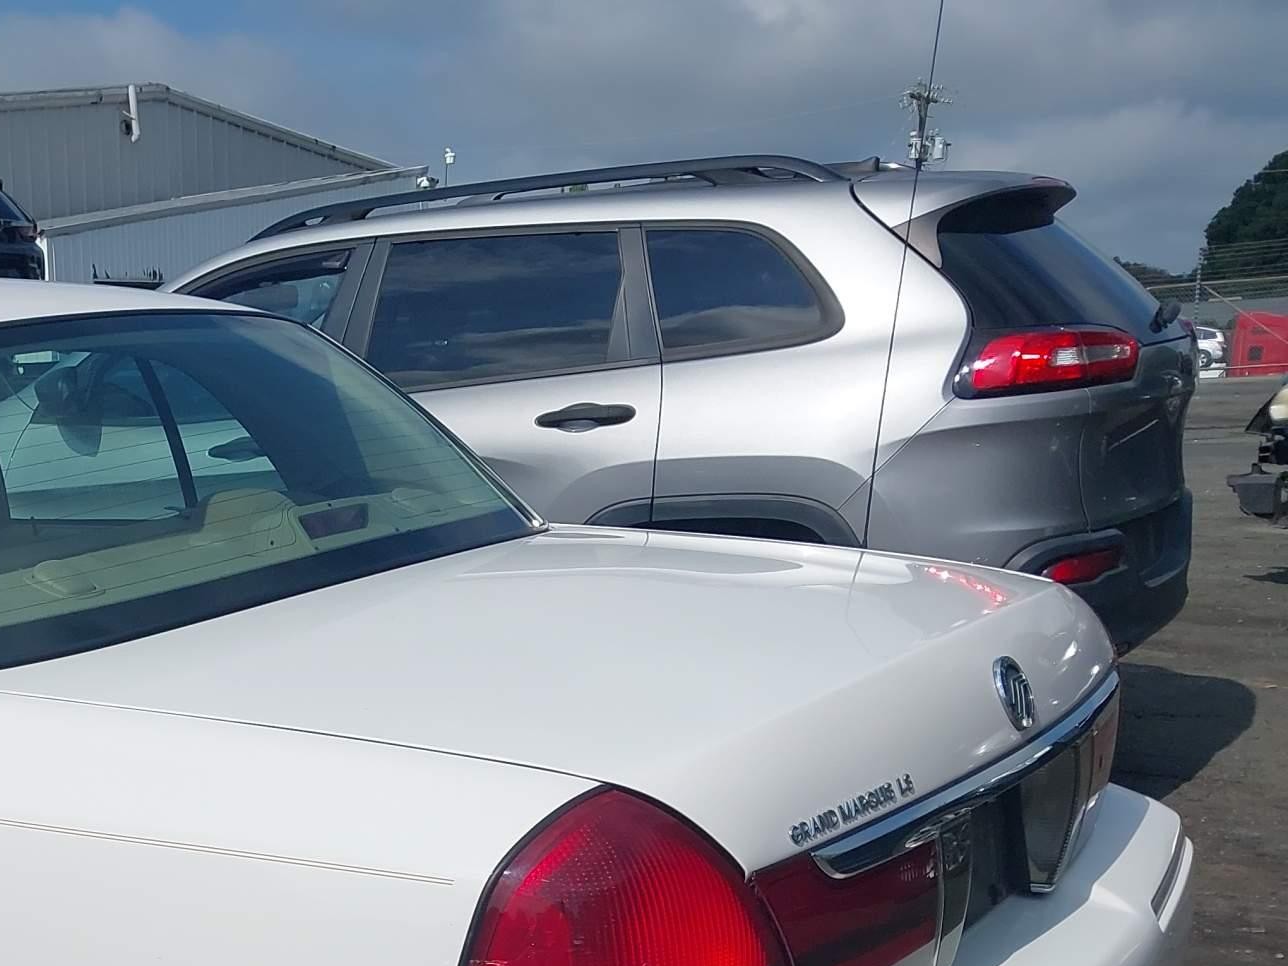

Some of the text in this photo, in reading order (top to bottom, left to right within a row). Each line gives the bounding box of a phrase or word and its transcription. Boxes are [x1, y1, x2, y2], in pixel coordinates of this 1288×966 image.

[789, 772, 915, 846] GRAND MARQUIS LS
